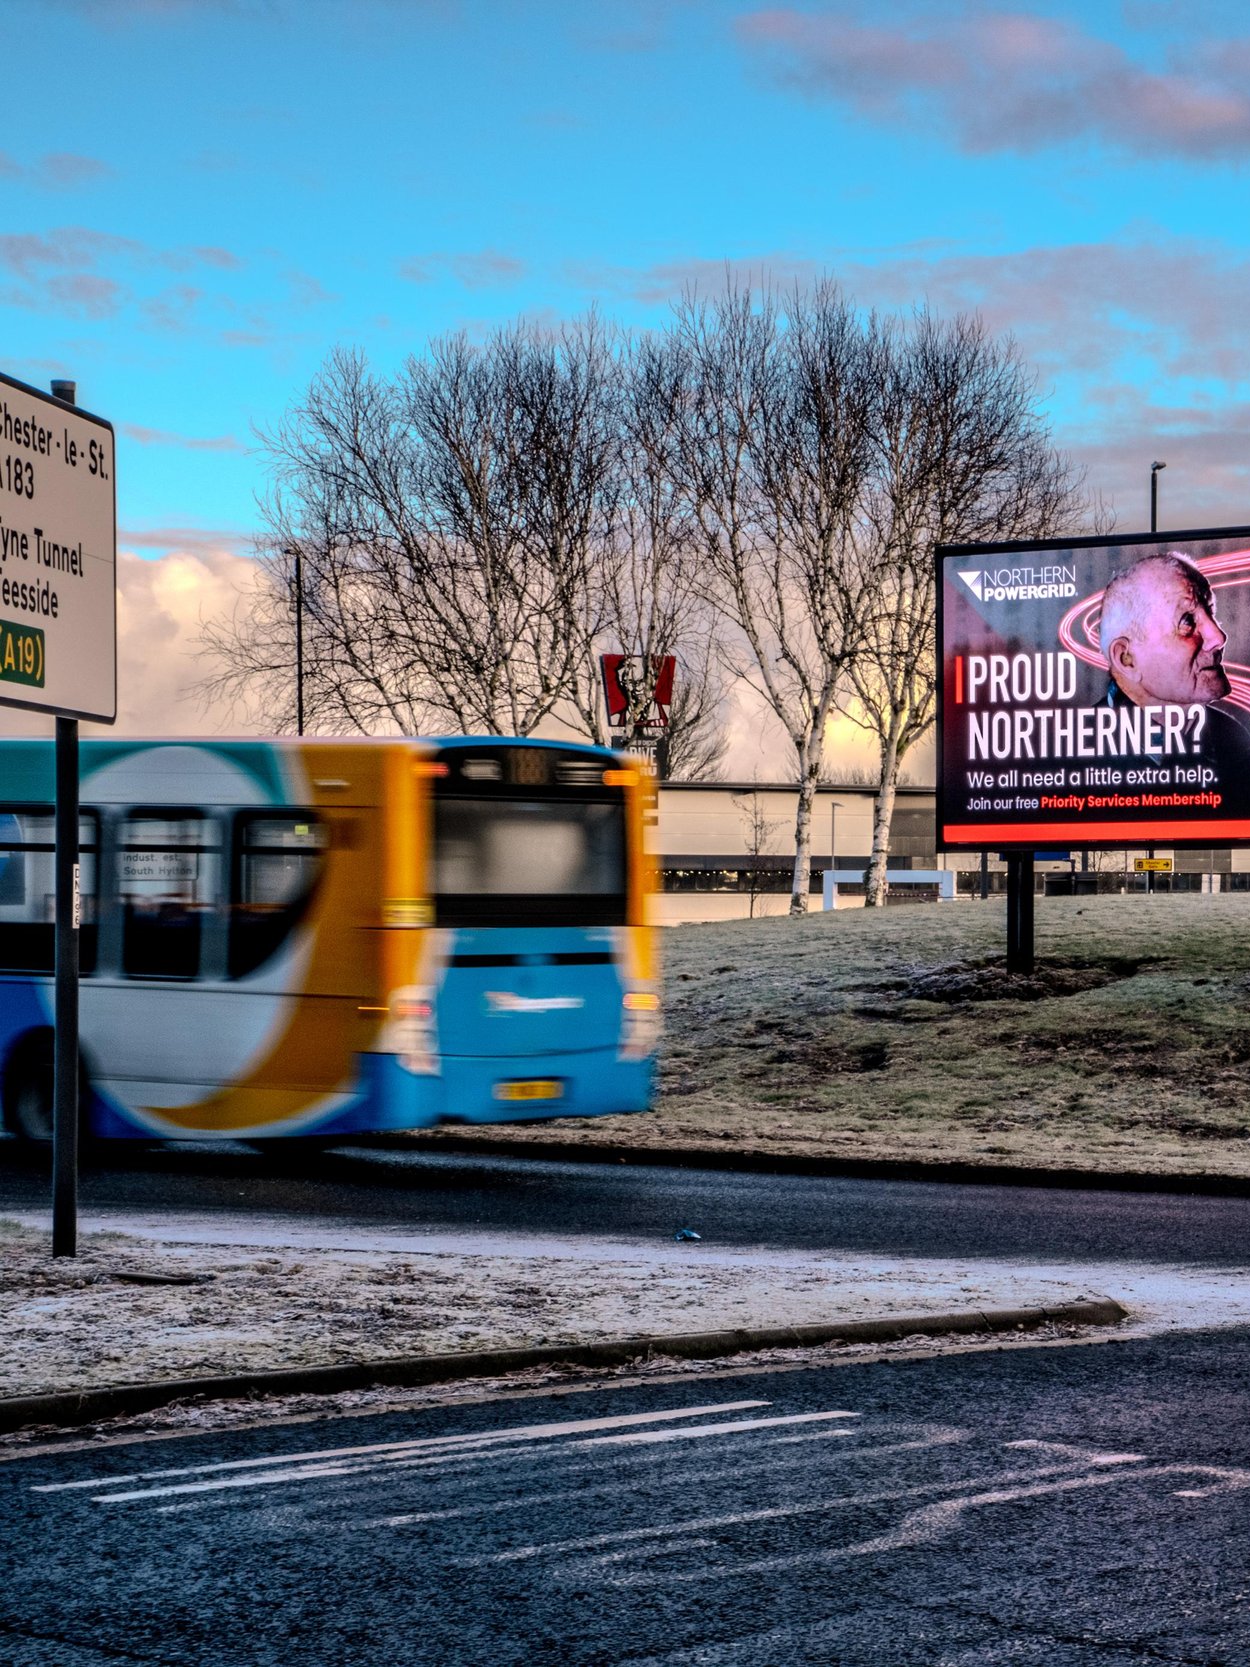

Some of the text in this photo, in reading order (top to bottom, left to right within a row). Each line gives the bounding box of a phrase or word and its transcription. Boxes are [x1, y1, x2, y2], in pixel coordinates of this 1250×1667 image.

[0, 515, 84, 578] yne Tunnel
[0, 567, 59, 619] eesside
[983, 565, 1076, 587] NORTHERN
[968, 651, 1078, 704] PROUD
[967, 703, 1207, 761] NORTHERNER?
[966, 764, 1219, 789] We all need a little extra help.
[967, 791, 1222, 812] Join our free Priority Services Membership
[123, 865, 193, 876] South Hylton
